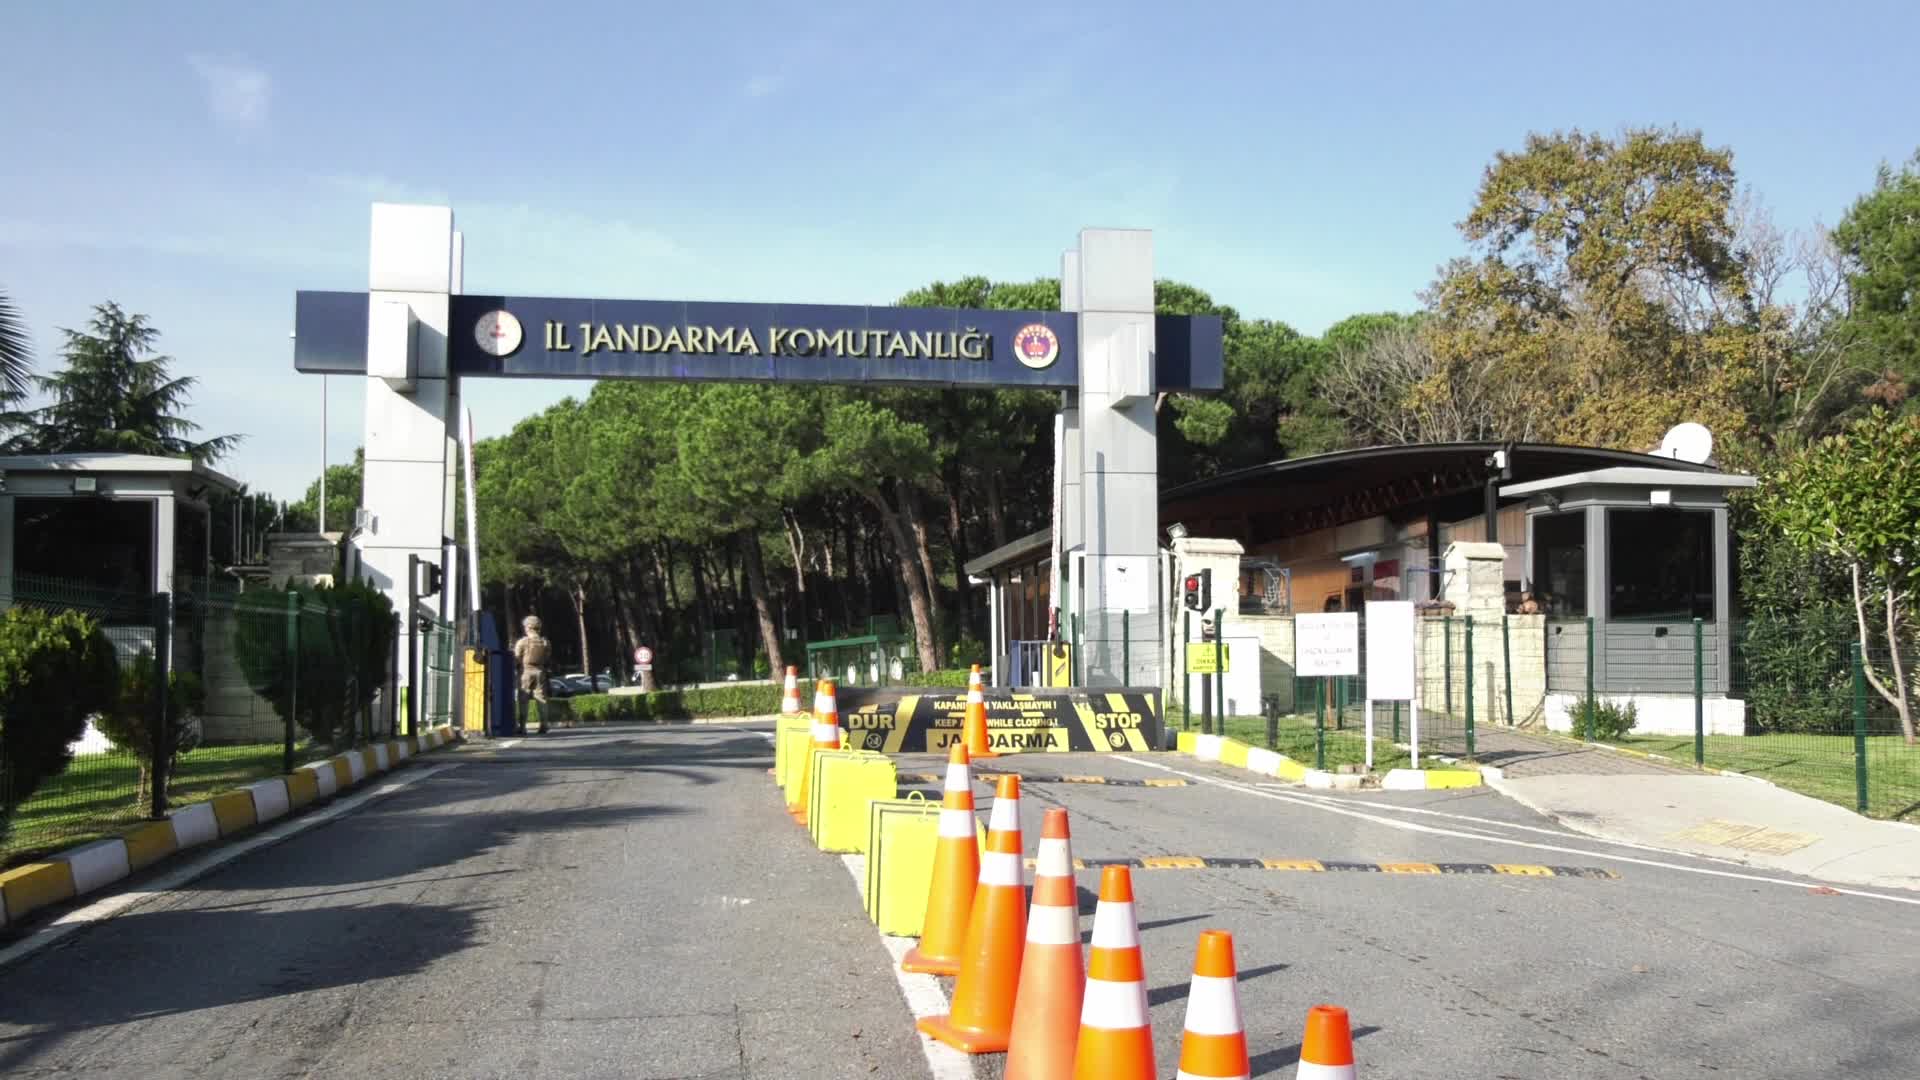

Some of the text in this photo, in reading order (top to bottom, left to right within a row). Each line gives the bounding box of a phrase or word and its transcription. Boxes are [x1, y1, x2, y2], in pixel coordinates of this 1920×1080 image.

[579, 323, 760, 354] JANDARMA
[991, 700, 1052, 711] YAKLAŞMAYIN
[848, 713, 894, 729] DUR
[935, 718, 958, 727] KEEP
[987, 718, 1014, 727] WHILE
[1096, 713, 1142, 729] STOP
[937, 733, 1058, 748] JADARMA
